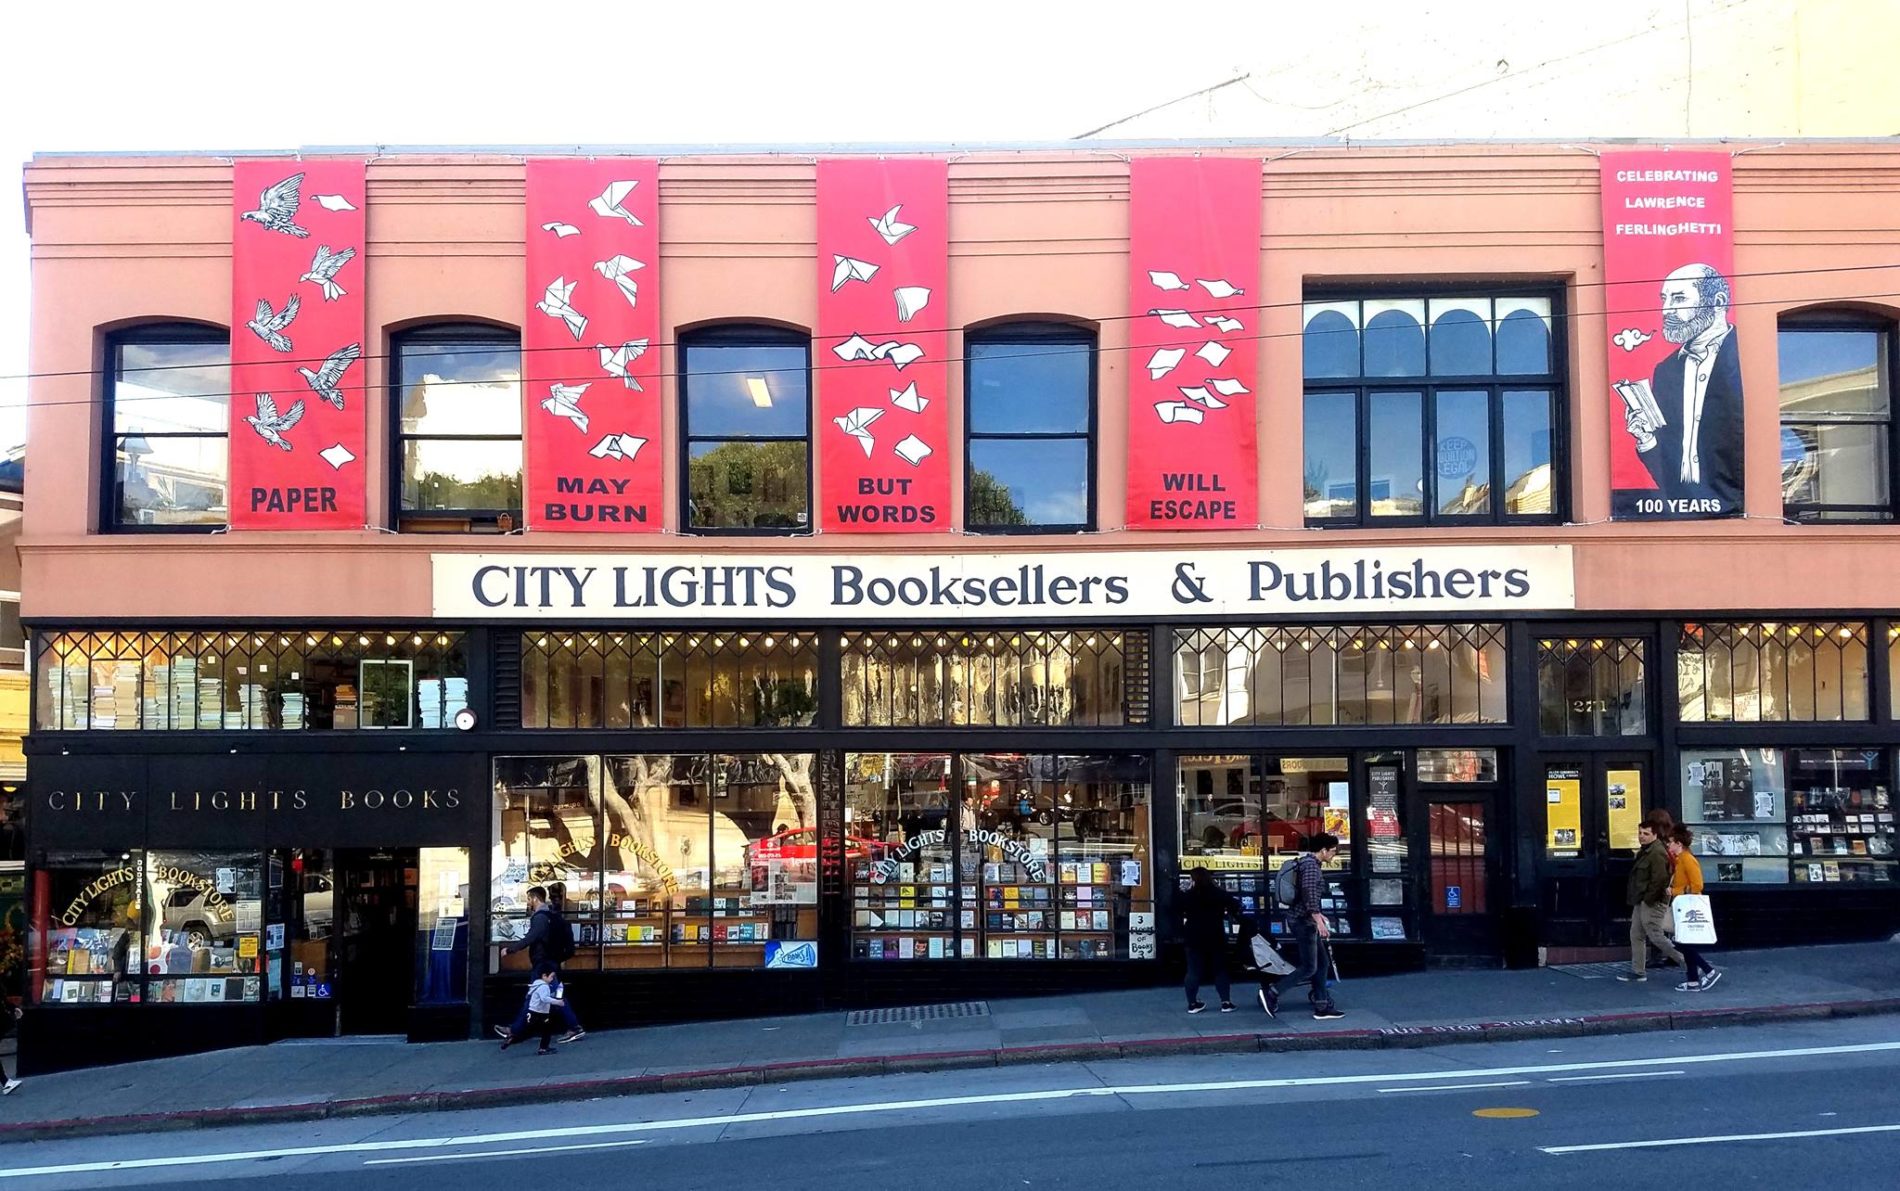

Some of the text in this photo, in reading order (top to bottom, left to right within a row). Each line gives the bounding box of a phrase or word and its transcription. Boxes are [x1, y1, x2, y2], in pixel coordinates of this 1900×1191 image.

[1616, 170, 1719, 183] CELEBRATING
[1625, 196, 1705, 209] LAWRENCE
[1615, 222, 1722, 236] FERLINGHETTI
[557, 477, 631, 494] MAY
[858, 478, 912, 495] BUT
[1163, 473, 1226, 492] WILL
[251, 487, 338, 513] PAPER
[1635, 499, 1721, 513] 100 YEARS
[545, 503, 647, 522] BURN
[837, 505, 936, 523] WORDS
[1150, 500, 1237, 520] ESCAPE
[472, 558, 1530, 608] CITY LIGHTS Booksellers & Publishers
[48, 789, 460, 811] CITY LIGHTS BOOKS
[874, 829, 1047, 885] CITY LIGHTS BOOKSTORE
[1183, 860, 1212, 869] CITY
[62, 865, 236, 927] CITY LIGHTS BOOKSTORE
[1137, 915, 1144, 924] 3
[1380, 1027, 1423, 1035] BUS
